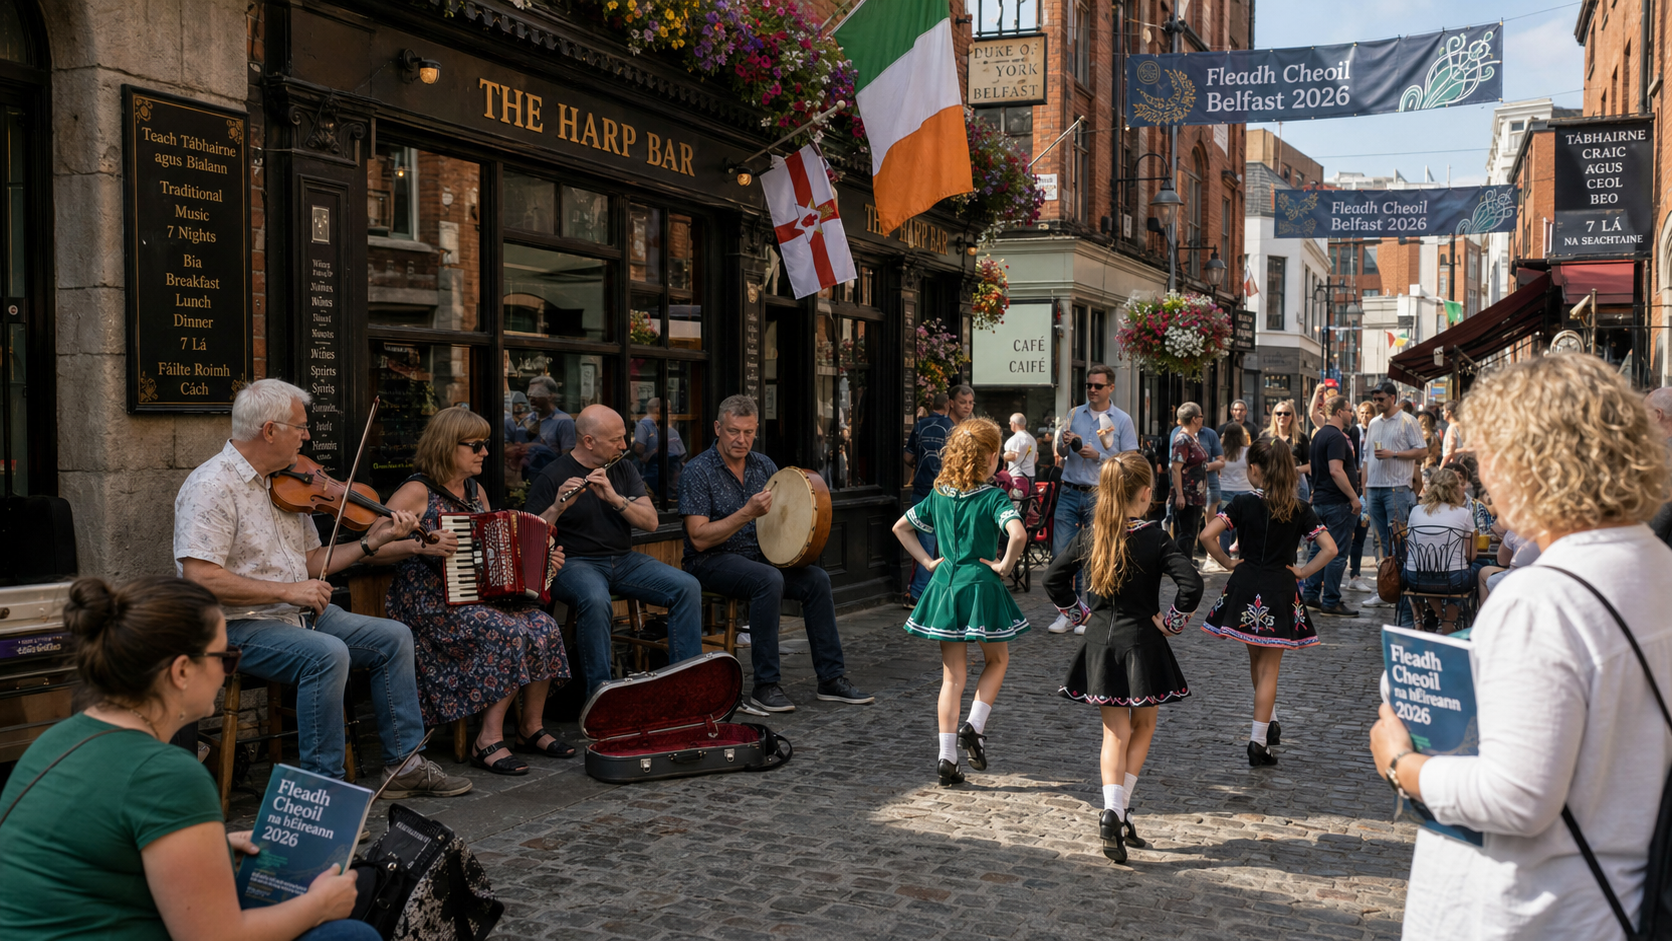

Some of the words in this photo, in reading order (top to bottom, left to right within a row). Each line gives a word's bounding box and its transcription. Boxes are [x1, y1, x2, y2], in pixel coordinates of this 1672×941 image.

[974, 45, 1014, 59] DUKE
[996, 63, 1038, 77] YORK
[1206, 65, 1277, 86] Fleadh
[1283, 60, 1351, 83] Cheoil
[974, 85, 1039, 99] BELFAST
[1206, 88, 1285, 113] Belfast
[1292, 85, 1351, 110] 2026
[479, 77, 544, 133] THE
[557, 103, 637, 158] HARP
[646, 131, 696, 178] BAR
[141, 127, 178, 147] Teach
[180, 134, 237, 158] Tábhairne
[1566, 130, 1646, 145] TÁBHAIRNE
[1582, 146, 1627, 160] CRAIC
[154, 152, 183, 169] agus
[186, 154, 228, 175] Bialann
[1585, 162, 1623, 175] AGUS
[159, 180, 223, 203] Traditional
[1586, 177, 1623, 190] CEOL
[1590, 193, 1619, 205] BEO
[174, 204, 211, 222] Music
[1331, 201, 1378, 215] Fleadh
[1382, 200, 1428, 215] Cheoil
[864, 203, 890, 237] TH
[930, 225, 948, 256] BAR
[1331, 217, 1383, 231] Belfast
[1387, 217, 1427, 231] 2026
[1585, 220, 1595, 233] 7
[1601, 216, 1622, 232] LÁ
[167, 225, 175, 239] 7
[178, 225, 217, 245] Nights
[1564, 237, 1579, 246] NA
[1581, 234, 1643, 246] SEACHTAINE
[183, 253, 203, 269] Bia
[165, 272, 221, 290] Breakfast
[175, 293, 212, 309] Lunch
[173, 313, 214, 329] Dinner
[180, 337, 188, 350] 7
[192, 337, 207, 351] Lá
[1013, 335, 1046, 352] CAFÉ
[157, 361, 191, 377] Fáilte
[193, 362, 231, 377] Roimh
[1009, 357, 1046, 373] CAIFÉ
[180, 381, 209, 396] Cách
[1390, 643, 1443, 672] Fleadh
[1392, 664, 1441, 691] Cheoil
[1394, 687, 1408, 701] na
[1395, 700, 1432, 726] 2026
[277, 778, 331, 807] Fleadh
[272, 795, 324, 822] Cheoil
[267, 813, 281, 825] na
[261, 825, 300, 848] 2026
